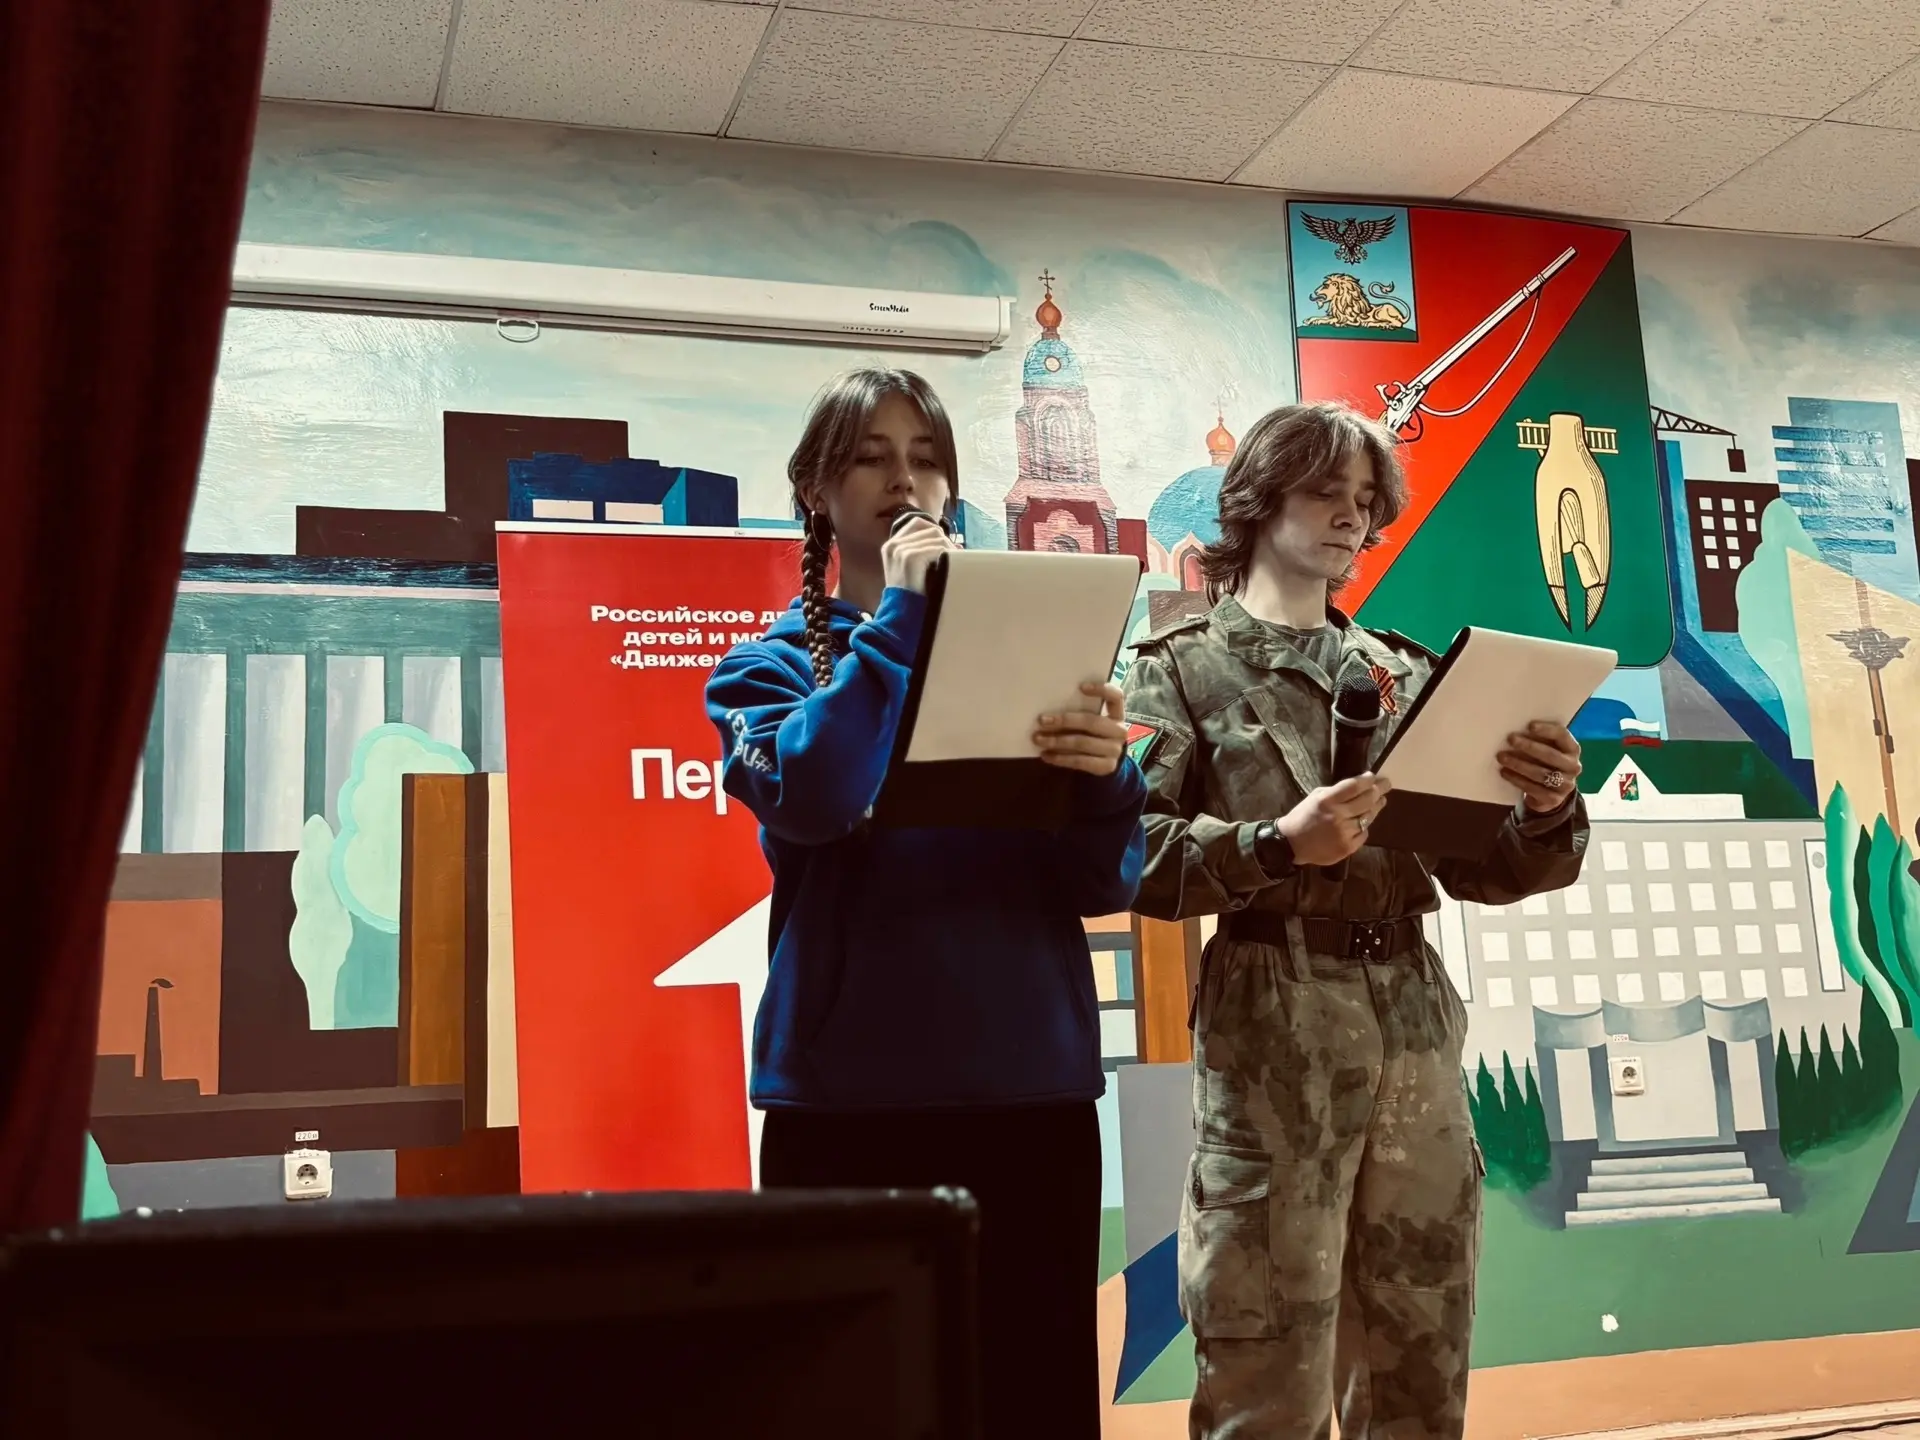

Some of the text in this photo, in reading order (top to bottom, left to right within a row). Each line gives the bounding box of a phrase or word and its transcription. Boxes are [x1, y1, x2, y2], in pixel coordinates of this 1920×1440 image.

[869, 302, 909, 313] ScreenMedia
[591, 605, 755, 624] Российское
[623, 628, 703, 647] детей
[708, 631, 725, 645] и
